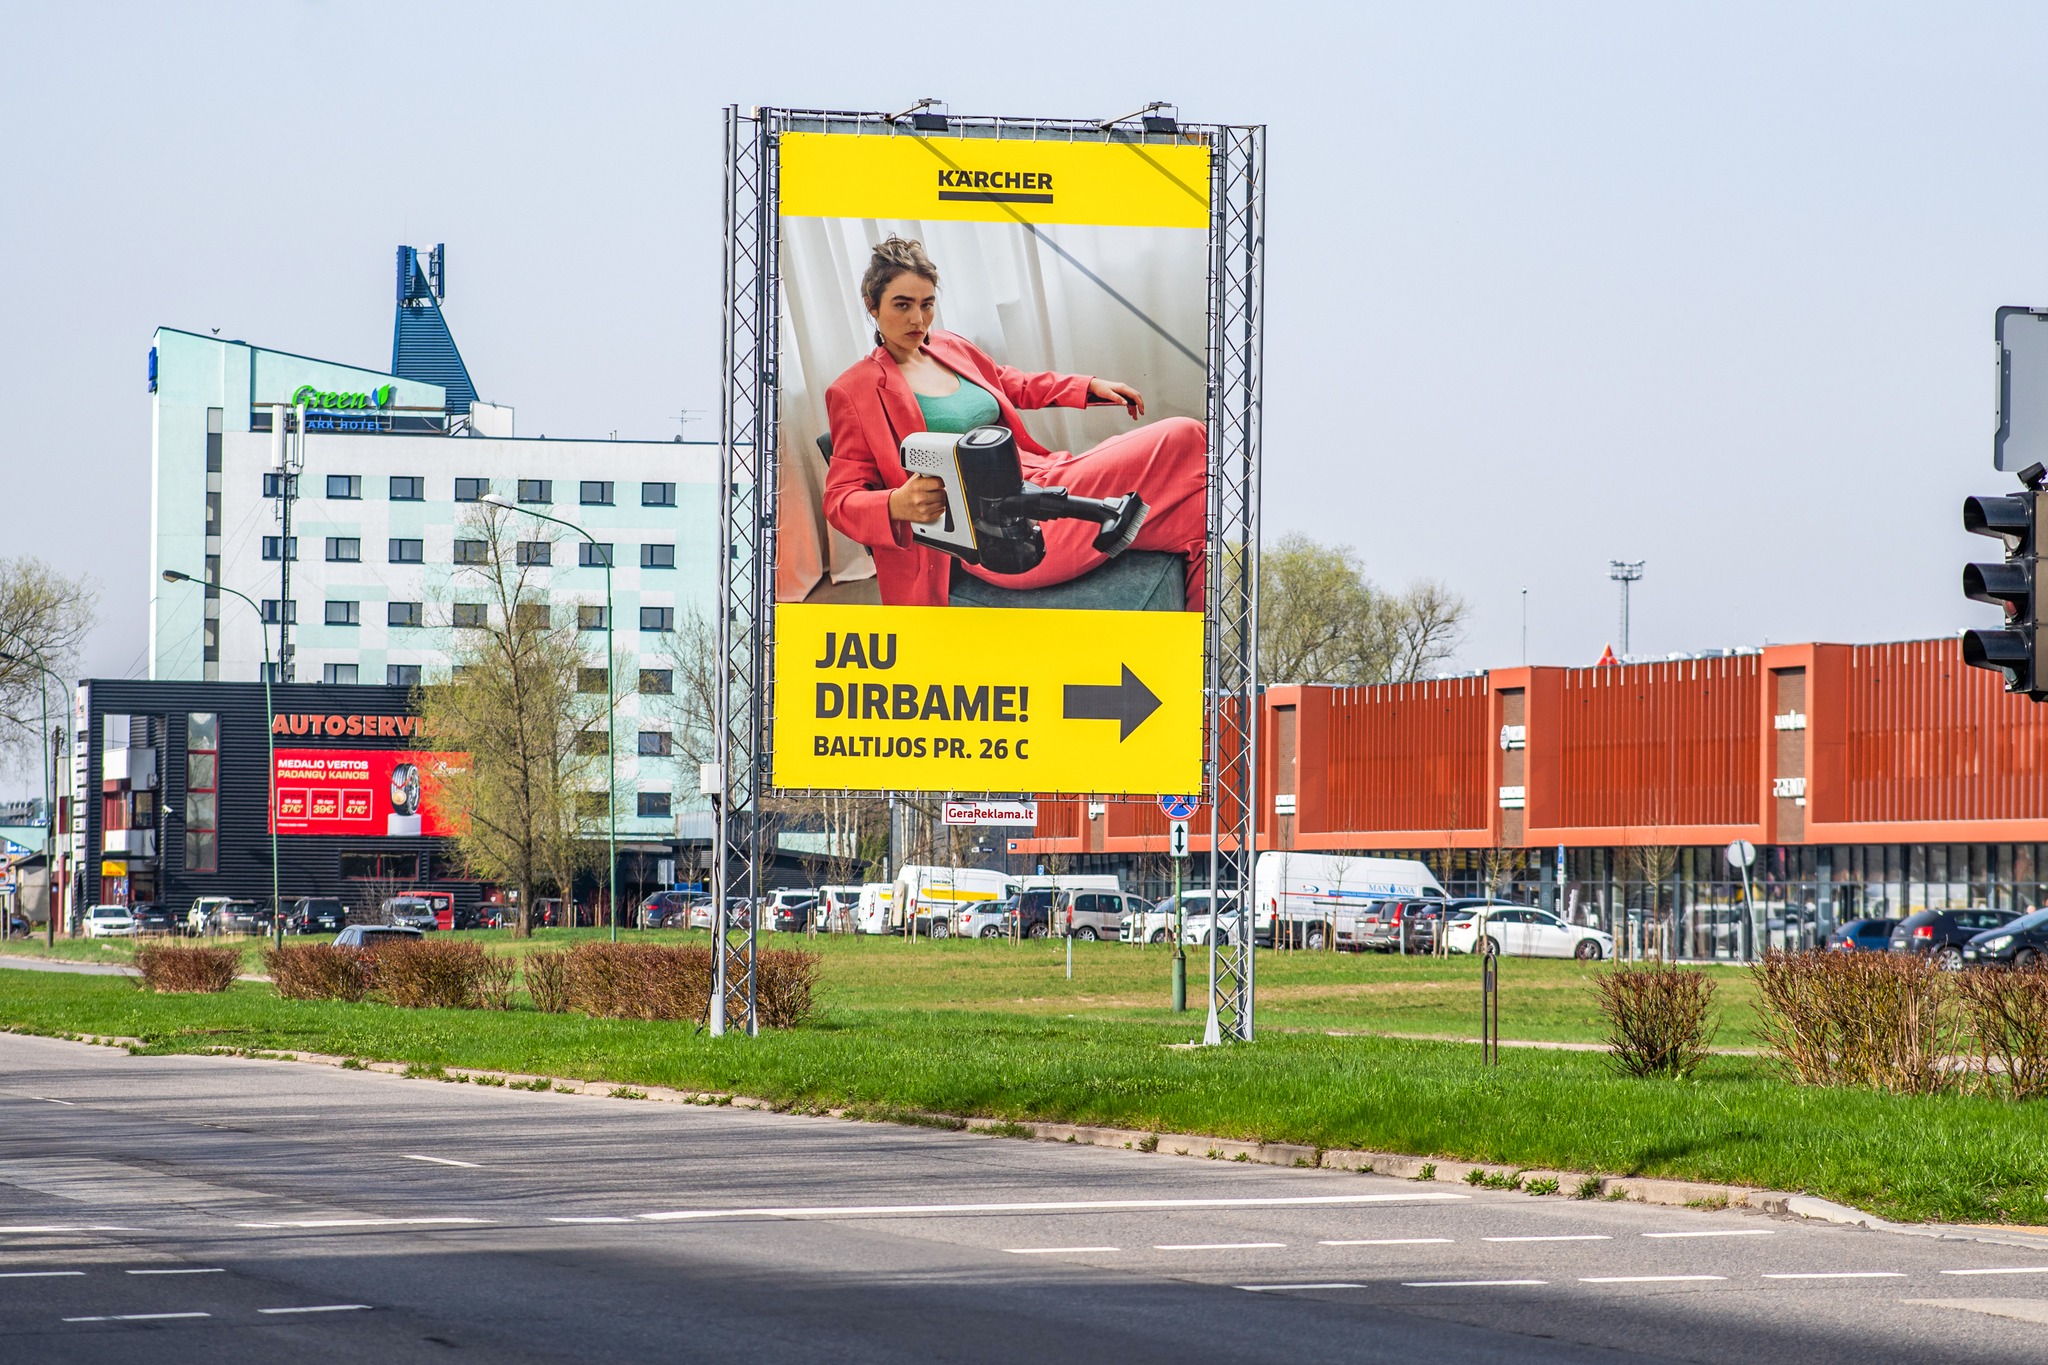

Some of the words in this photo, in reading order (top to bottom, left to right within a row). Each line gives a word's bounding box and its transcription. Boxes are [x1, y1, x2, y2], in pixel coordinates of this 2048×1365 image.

[938, 169, 1053, 190] KÄRCHER
[291, 385, 367, 412] Green
[304, 419, 335, 429] ARK
[340, 420, 383, 431] HOTEL
[815, 631, 897, 670] JAU
[815, 681, 1030, 723] DIRBAME!
[813, 735, 927, 759] BALTIJOS
[933, 737, 972, 759] PR.
[979, 738, 1008, 760] 26
[1015, 738, 1029, 760] C
[277, 759, 325, 769] MEDALIO
[326, 760, 369, 770] VERTOS
[328, 770, 369, 780] KAINOS!
[948, 807, 1034, 820] GeraReklama.lt
